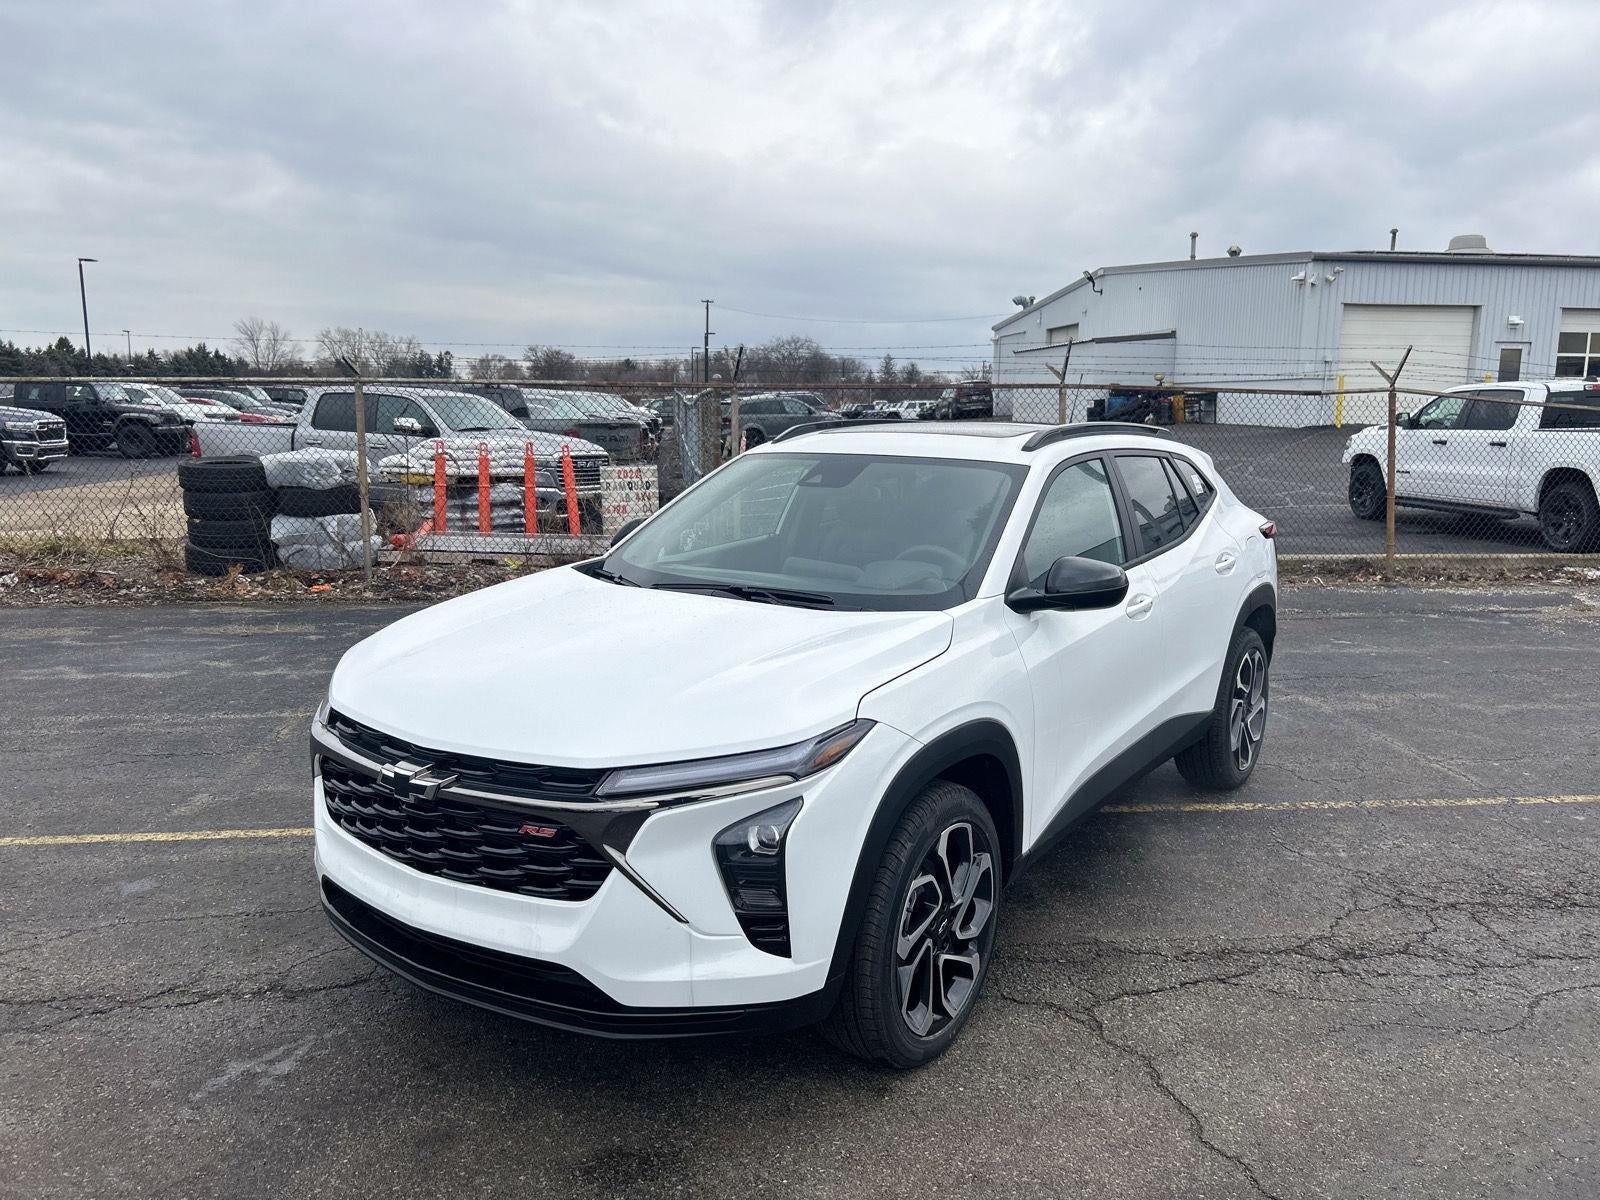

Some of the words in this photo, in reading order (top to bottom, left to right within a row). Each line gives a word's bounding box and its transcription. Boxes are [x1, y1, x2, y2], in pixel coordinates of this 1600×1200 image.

[596, 434, 629, 442] RAM
[605, 481, 626, 491] RAM
[517, 824, 557, 838] RS
